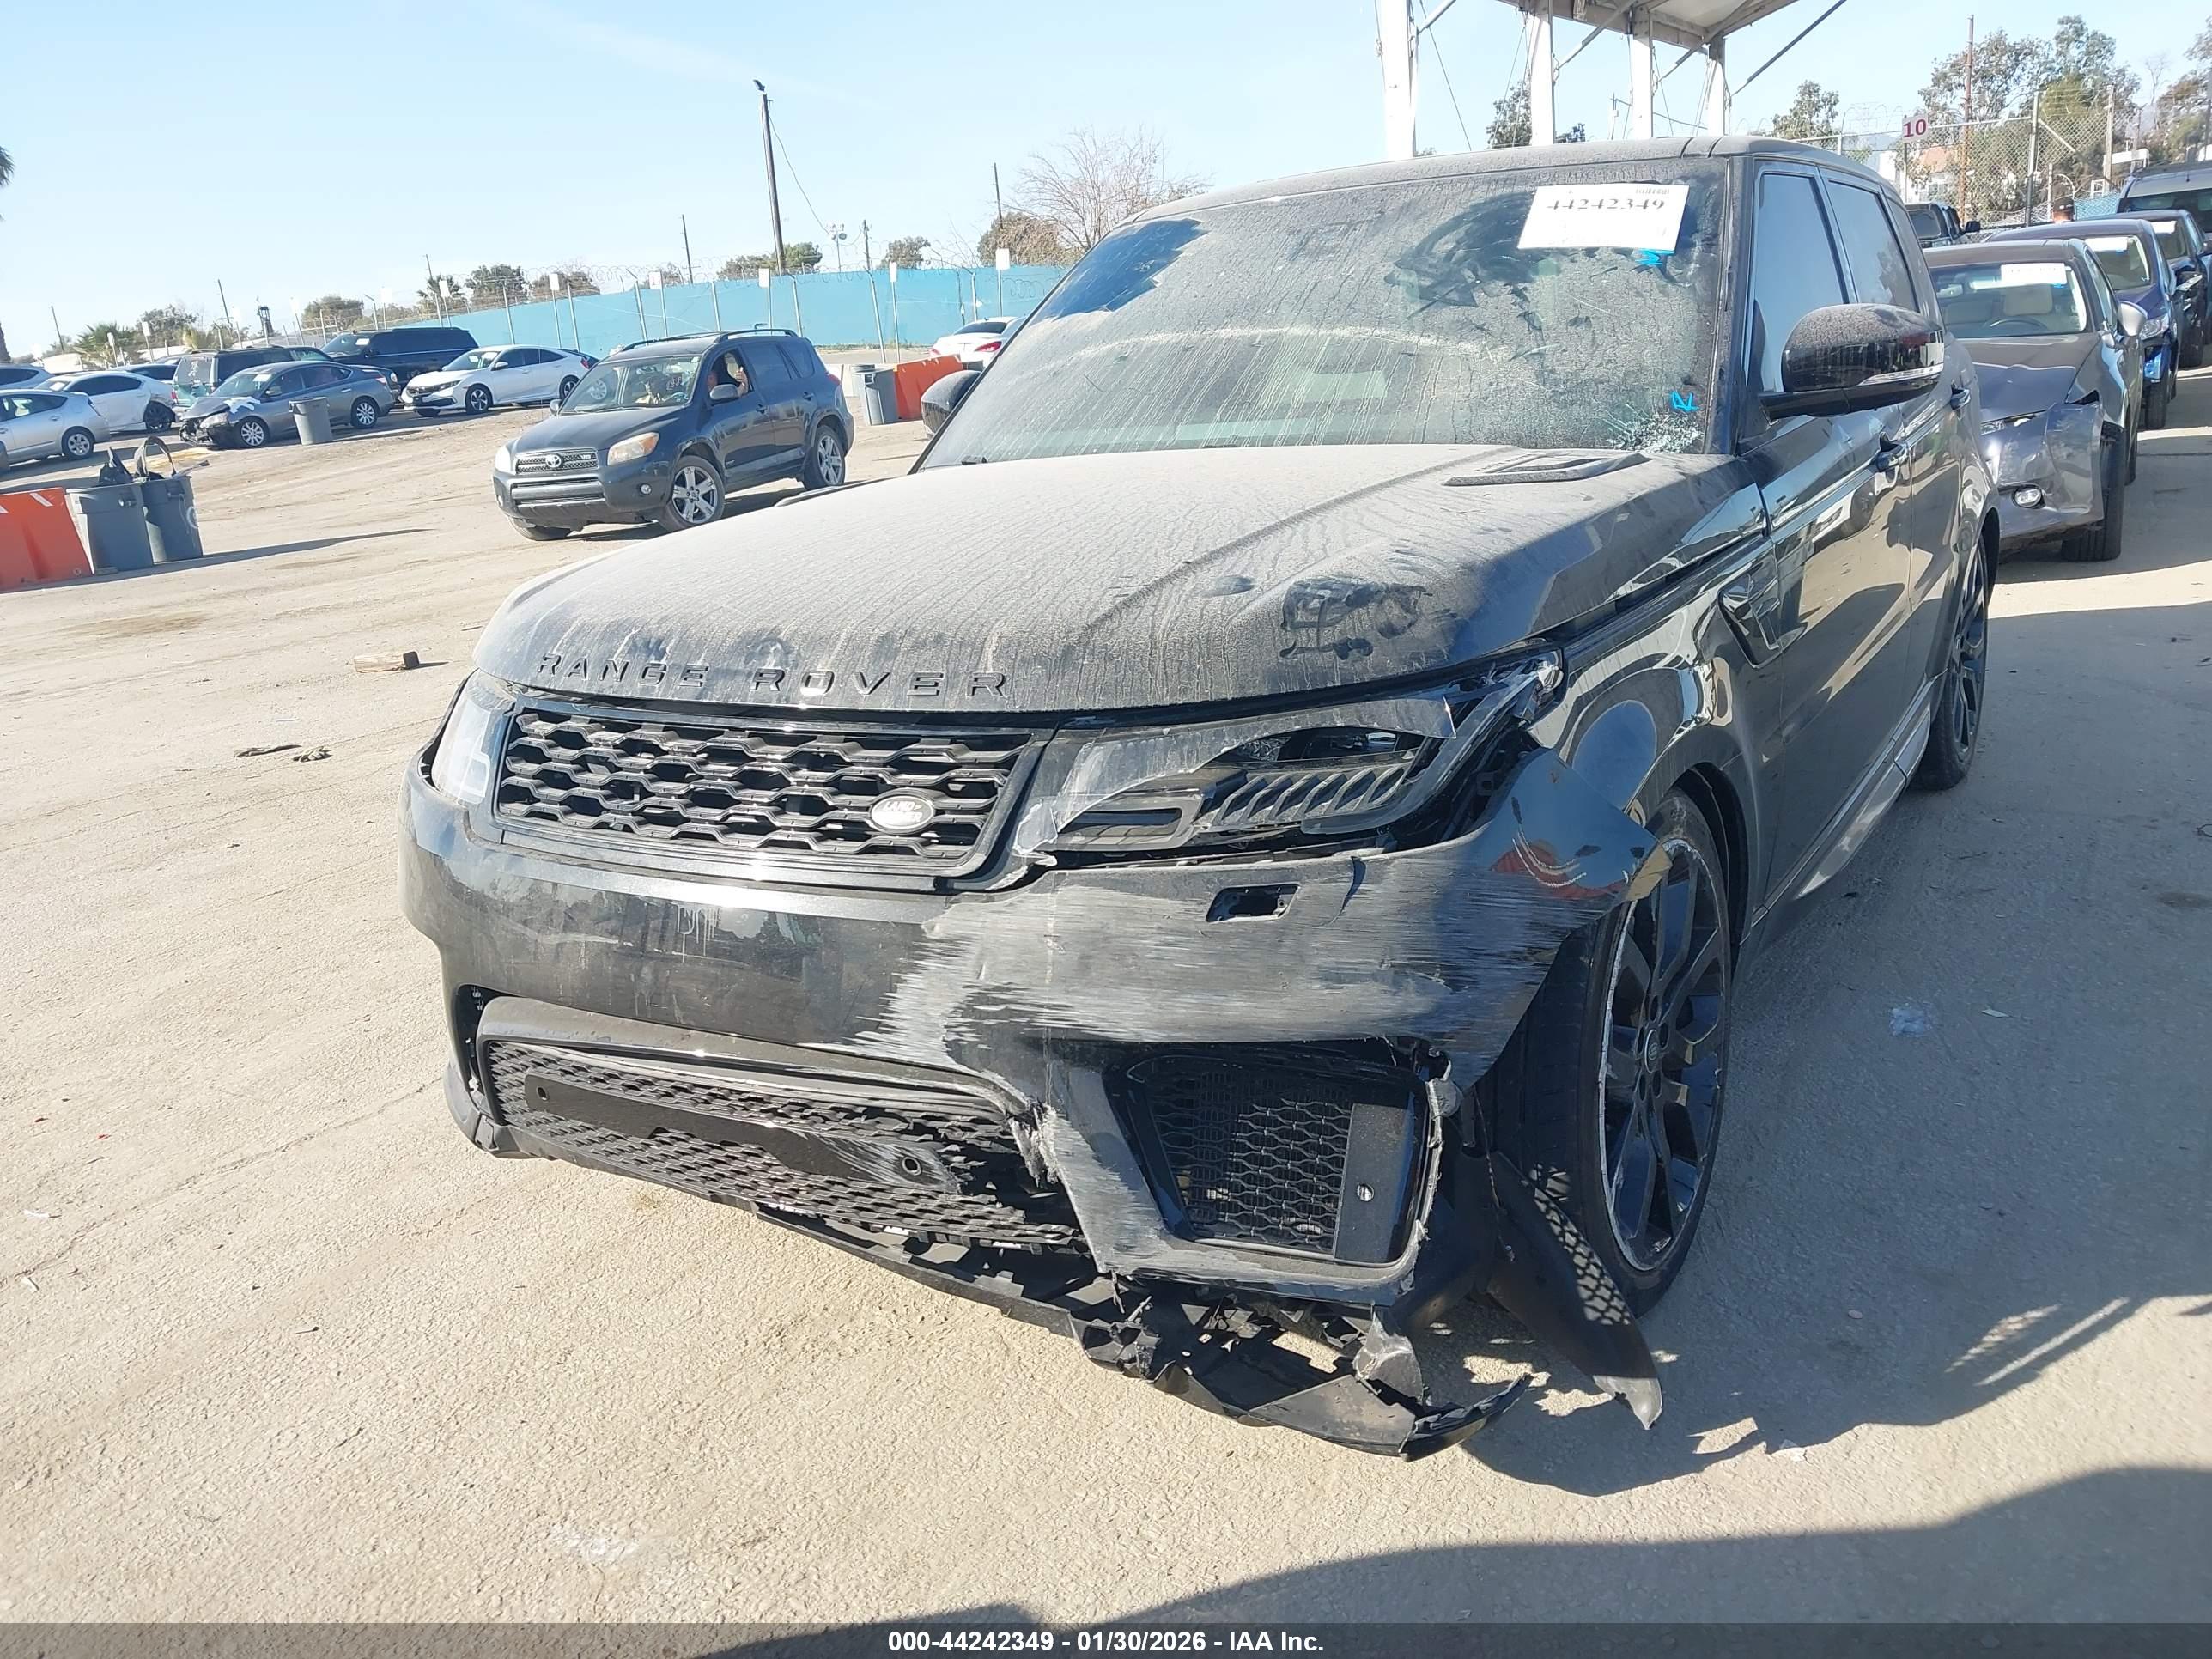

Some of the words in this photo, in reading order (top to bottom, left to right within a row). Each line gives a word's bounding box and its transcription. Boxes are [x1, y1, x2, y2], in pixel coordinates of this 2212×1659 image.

[1903, 118, 1927, 137] 10
[1547, 198, 1665, 210] 44242349
[536, 653, 710, 689] RANGE
[750, 668, 1007, 698] ROVER
